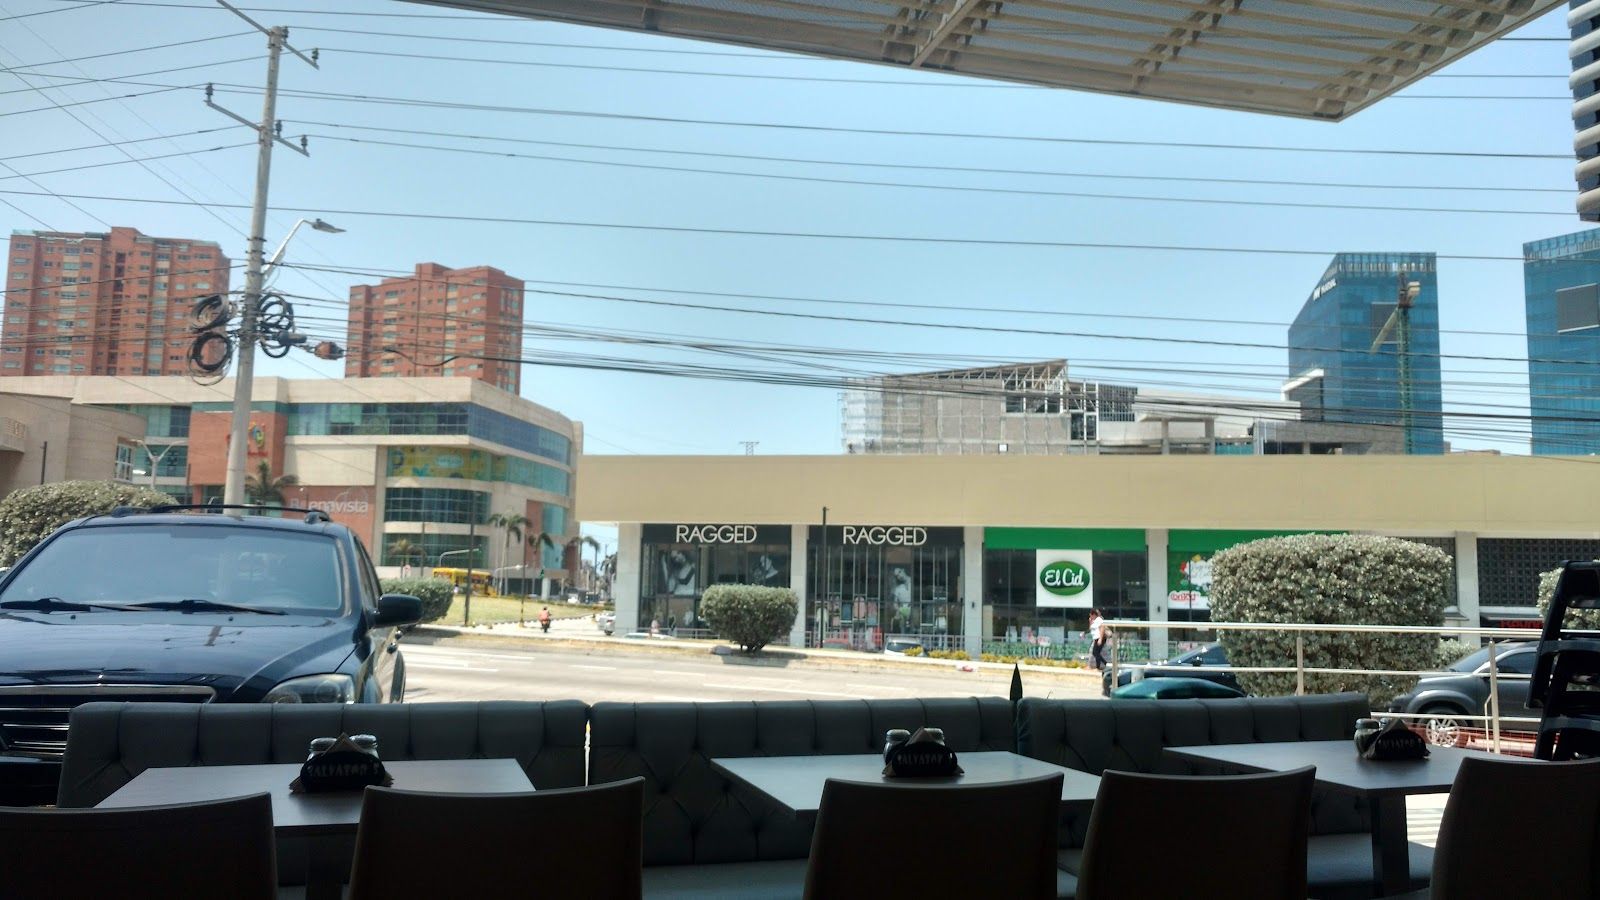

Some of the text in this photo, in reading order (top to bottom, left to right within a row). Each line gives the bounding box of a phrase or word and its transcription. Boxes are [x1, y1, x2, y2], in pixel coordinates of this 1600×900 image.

[675, 524, 757, 544] RAGGED
[842, 525, 928, 546] RAGGED
[1044, 568, 1085, 587] El Cid
